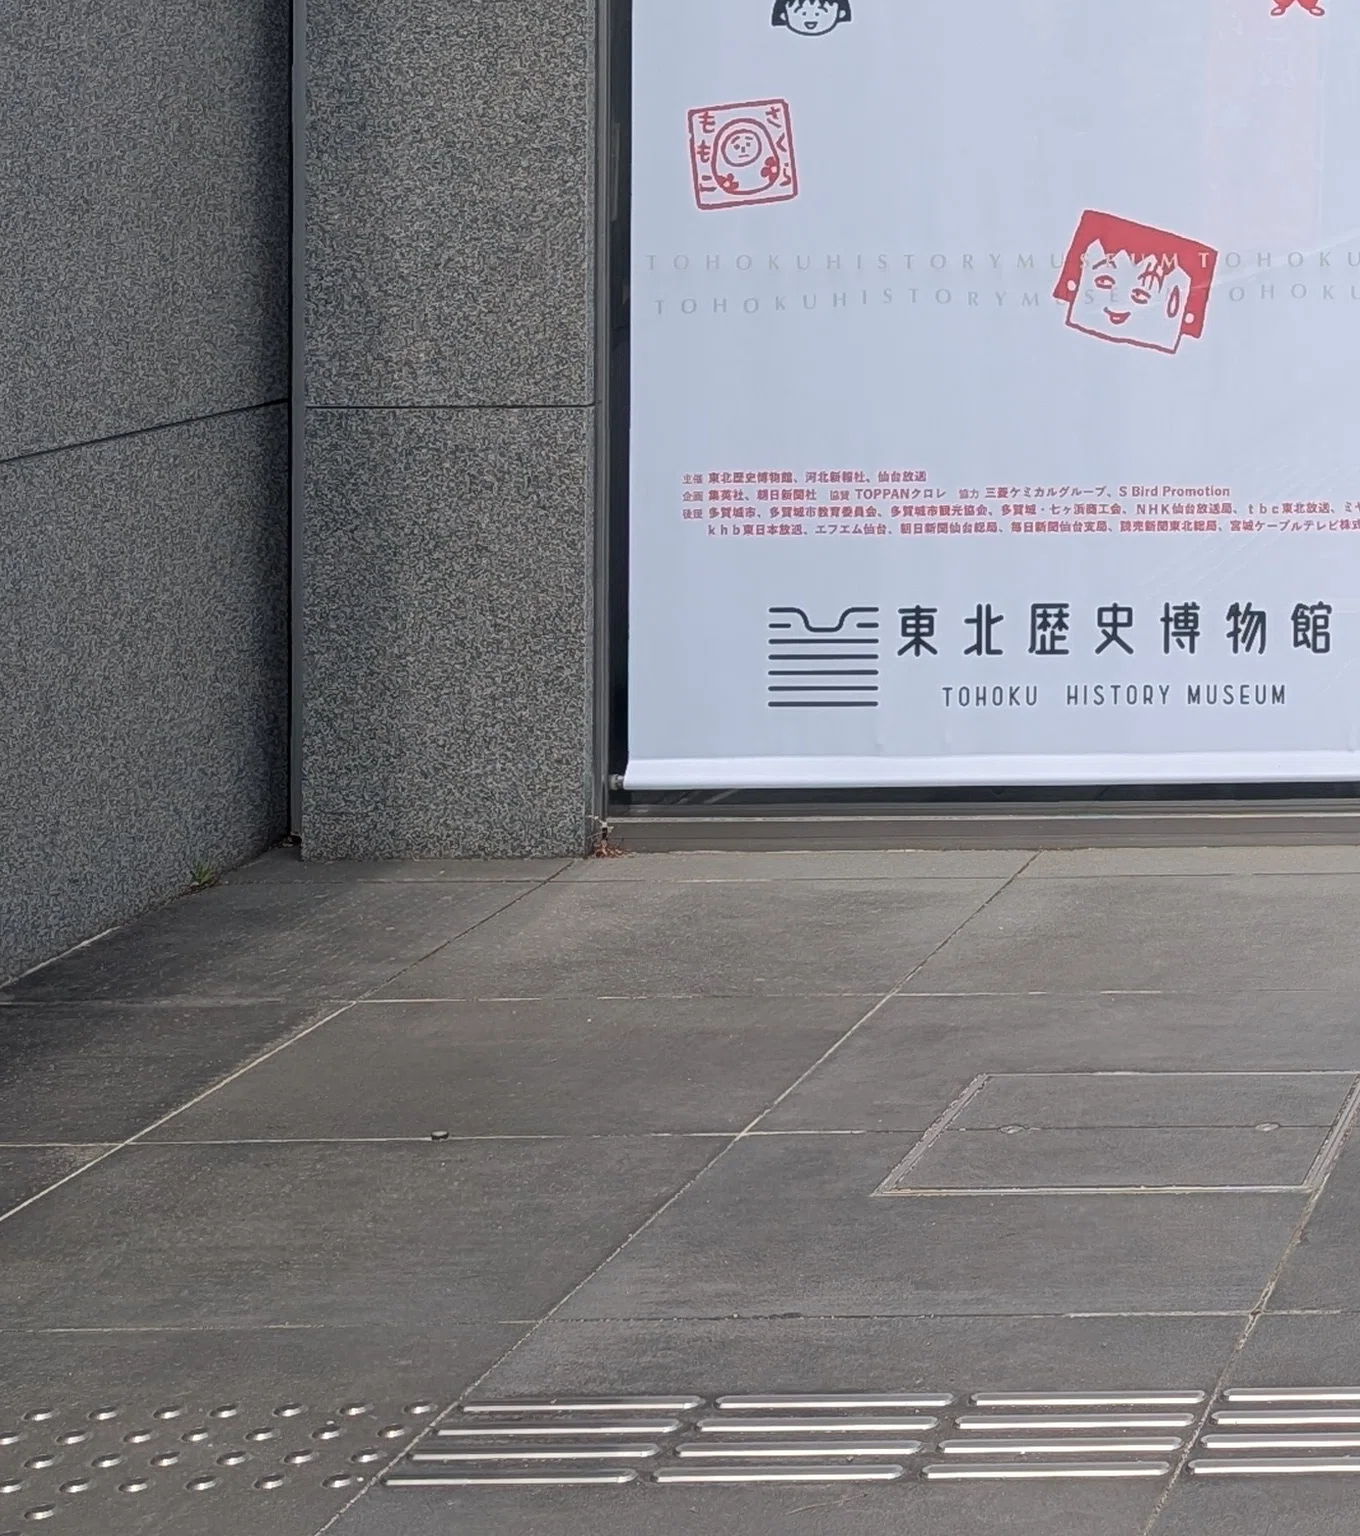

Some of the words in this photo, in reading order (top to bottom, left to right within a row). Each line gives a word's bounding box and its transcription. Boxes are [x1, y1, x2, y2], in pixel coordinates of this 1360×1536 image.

[1131, 485, 1159, 497] Bird
[1162, 484, 1231, 498] Promotion
[896, 601, 1334, 658] 東北歴史博物館
[941, 684, 1039, 708] TOHOKU
[1066, 684, 1172, 707] HISTORY
[1187, 683, 1288, 706] MUSEUM
